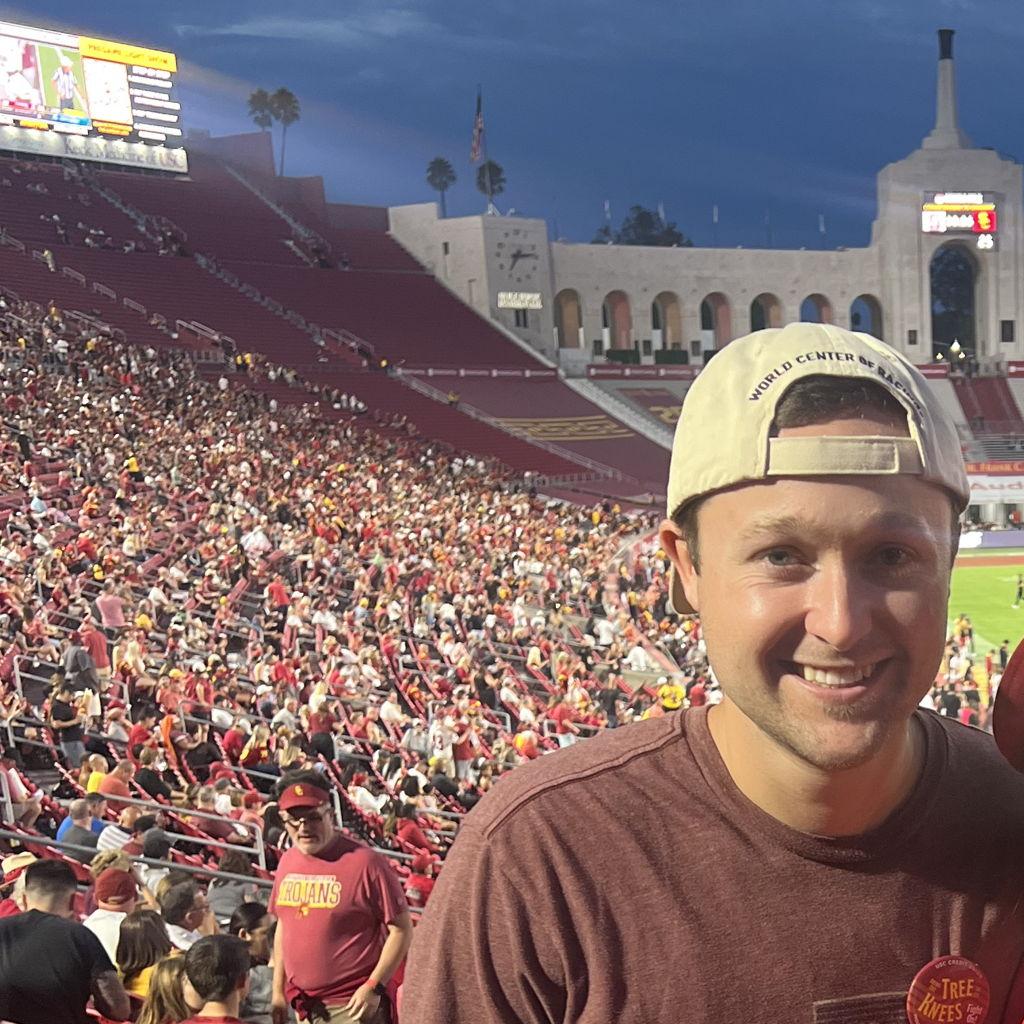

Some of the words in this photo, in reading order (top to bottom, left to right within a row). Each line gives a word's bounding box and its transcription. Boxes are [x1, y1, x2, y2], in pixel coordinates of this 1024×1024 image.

[749, 360, 793, 402] WORLD
[795, 351, 855, 364] CENTER
[858, 355, 876, 369] OF
[278, 880, 341, 906] TROJANS
[941, 977, 975, 1000] TREE
[917, 992, 963, 1022] KNEES
